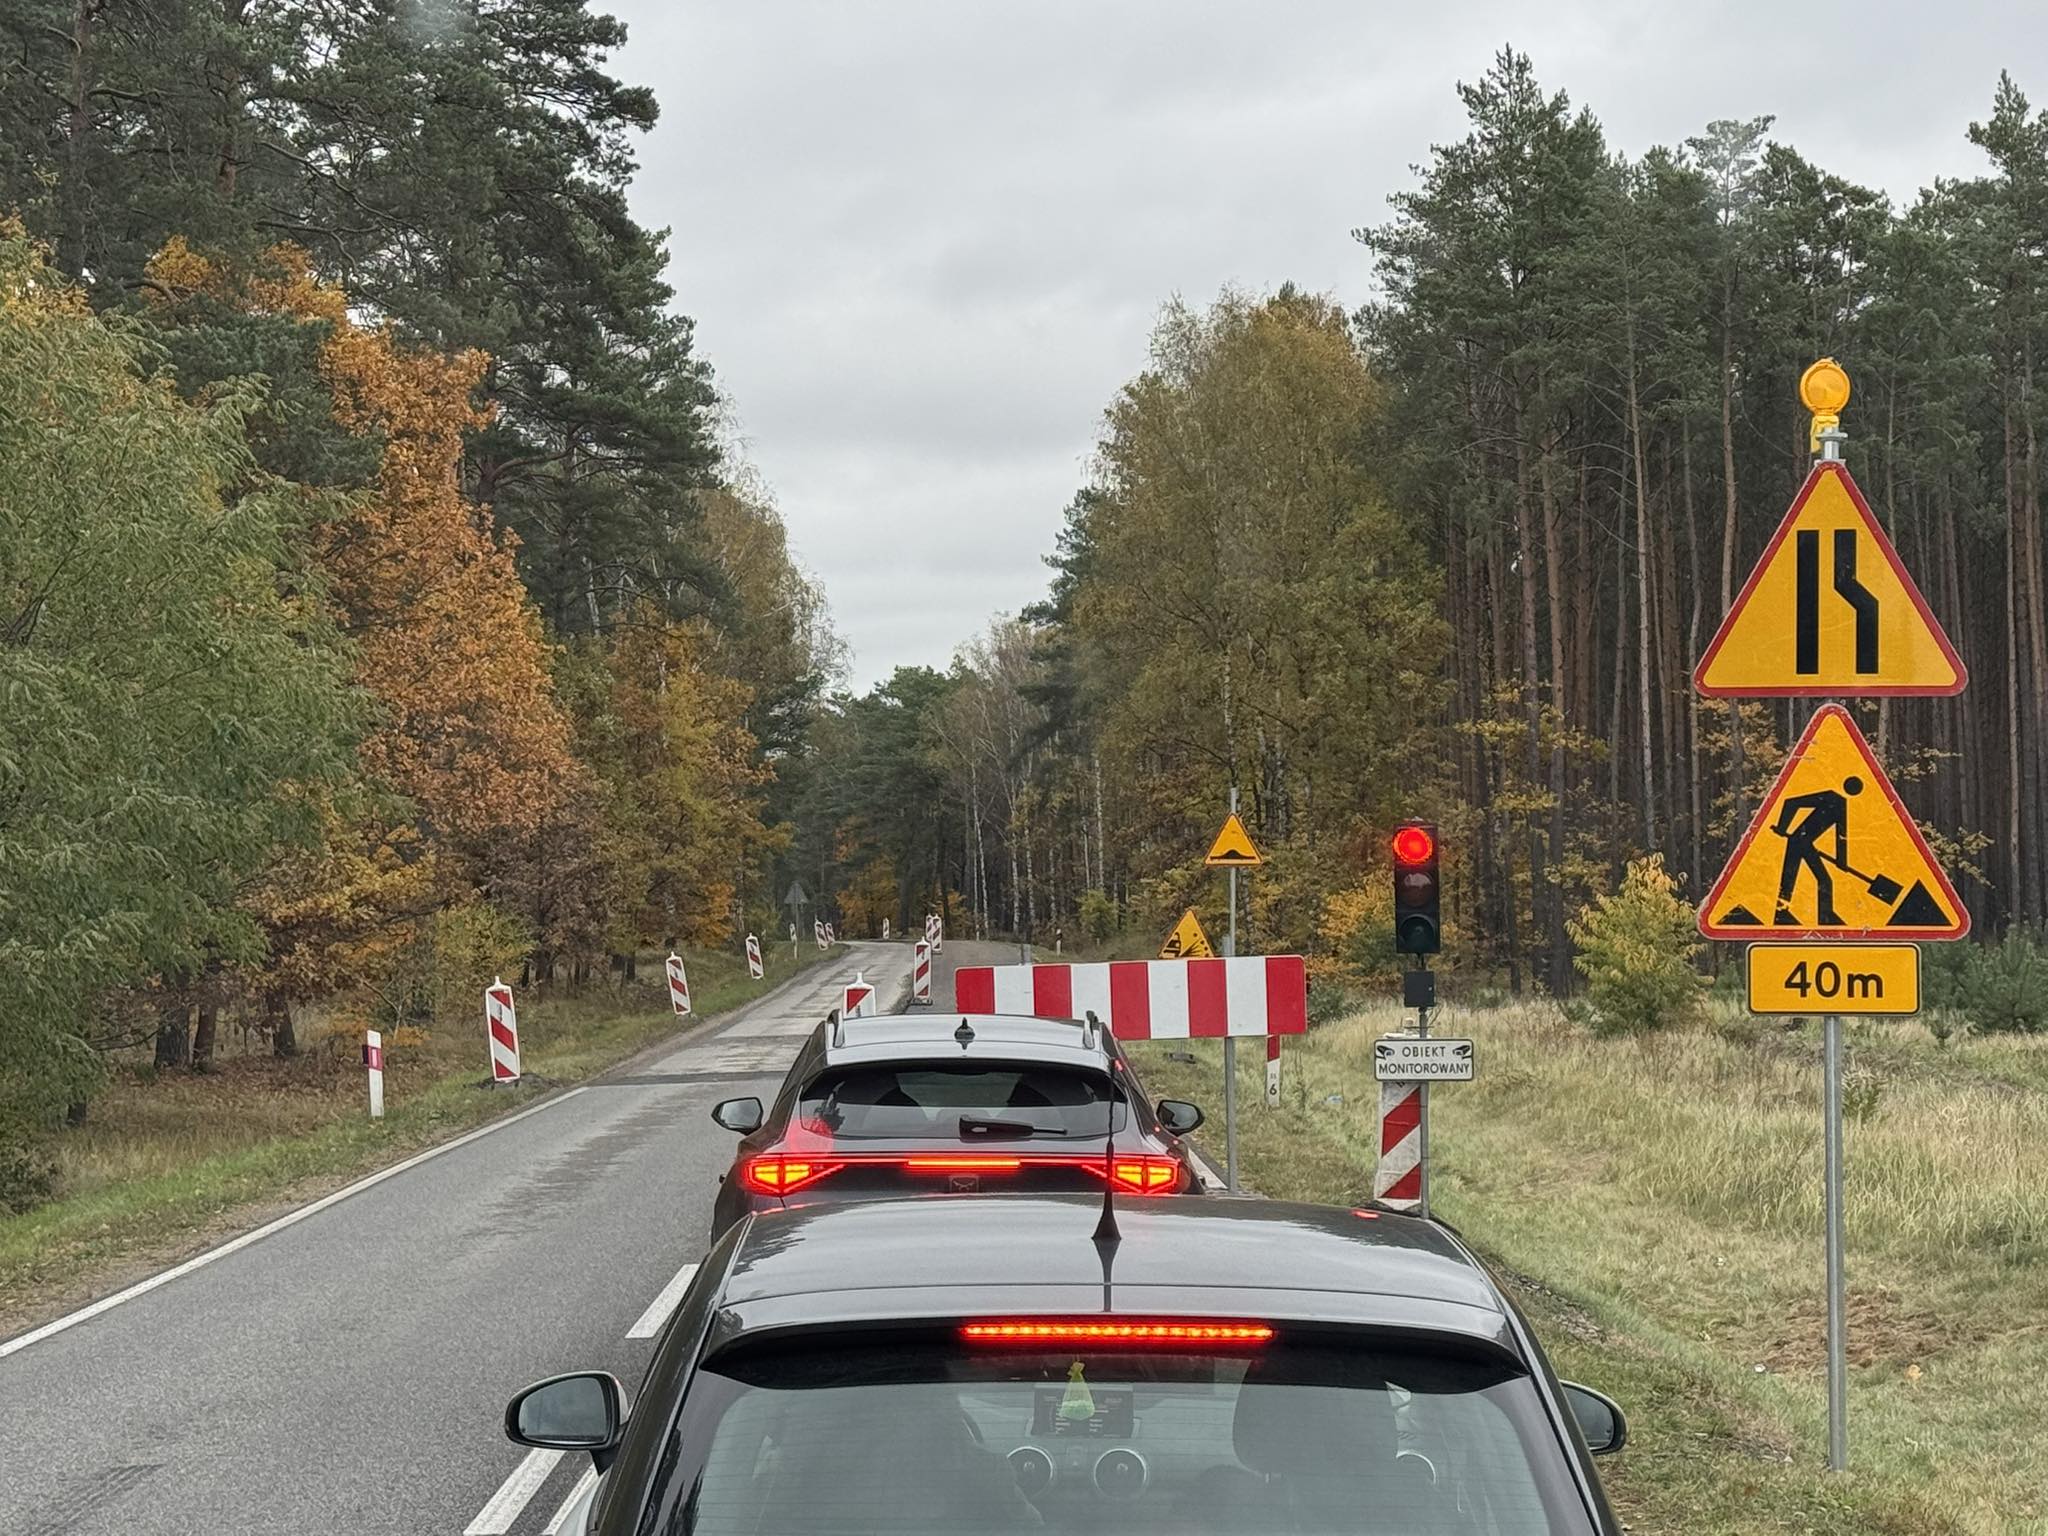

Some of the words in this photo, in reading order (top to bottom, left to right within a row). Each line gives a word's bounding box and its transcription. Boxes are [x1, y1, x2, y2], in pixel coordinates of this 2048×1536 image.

[1402, 1046, 1446, 1057] OBIEKT
[1379, 1063, 1470, 1074] MONITOROWANY
[1269, 1083, 1278, 1095] 6
